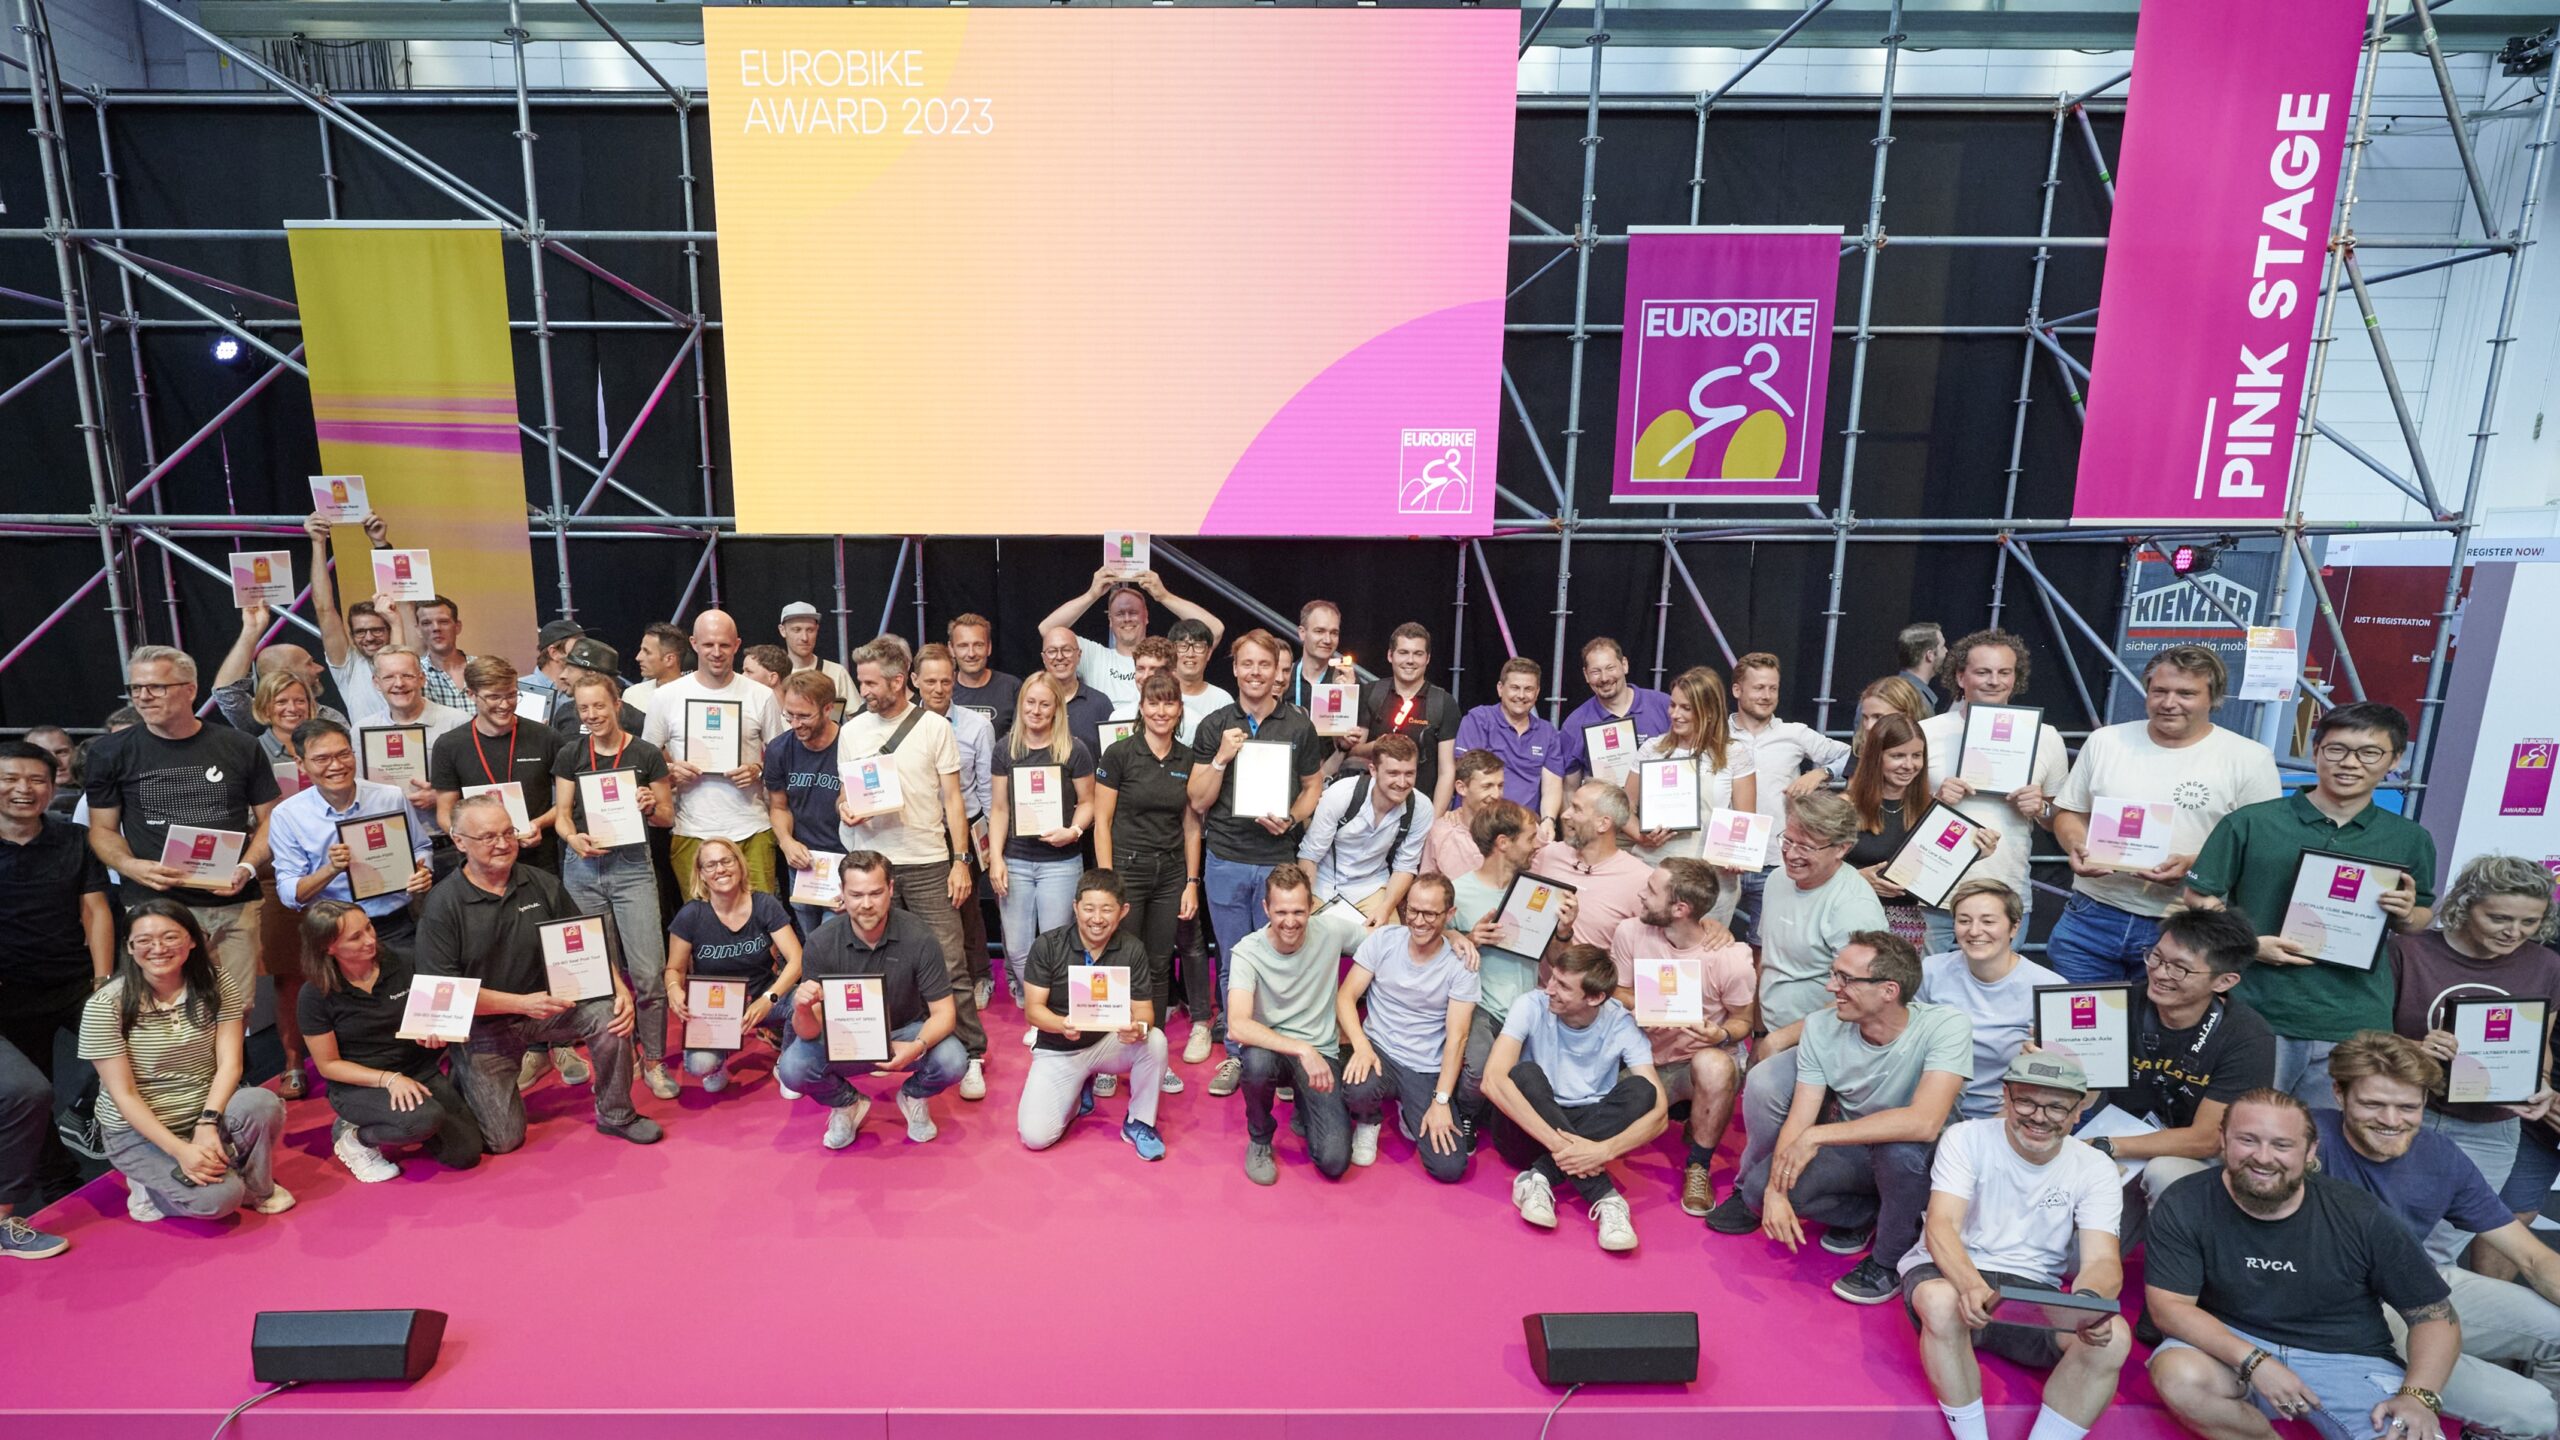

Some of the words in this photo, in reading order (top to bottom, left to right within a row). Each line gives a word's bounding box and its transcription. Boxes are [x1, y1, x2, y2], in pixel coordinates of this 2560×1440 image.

[740, 49, 925, 88] EUROBIKE
[743, 97, 888, 135] AWARD
[901, 97, 995, 135] 2023
[2247, 93, 2331, 320] STAGE
[1646, 306, 1813, 338] EUROBIKE
[2217, 342, 2290, 499] PINK
[1403, 431, 1474, 448] EUROBIKE
[2466, 547, 2513, 558] REGISTER
[2515, 547, 2545, 557] NOW!
[2135, 580, 2252, 623] KIENZLER
[2353, 615, 2371, 625] JUST
[2376, 616, 2432, 628] REGISTRATION
[697, 932, 767, 960] pinion
[2244, 1256, 2298, 1273] RVCA
